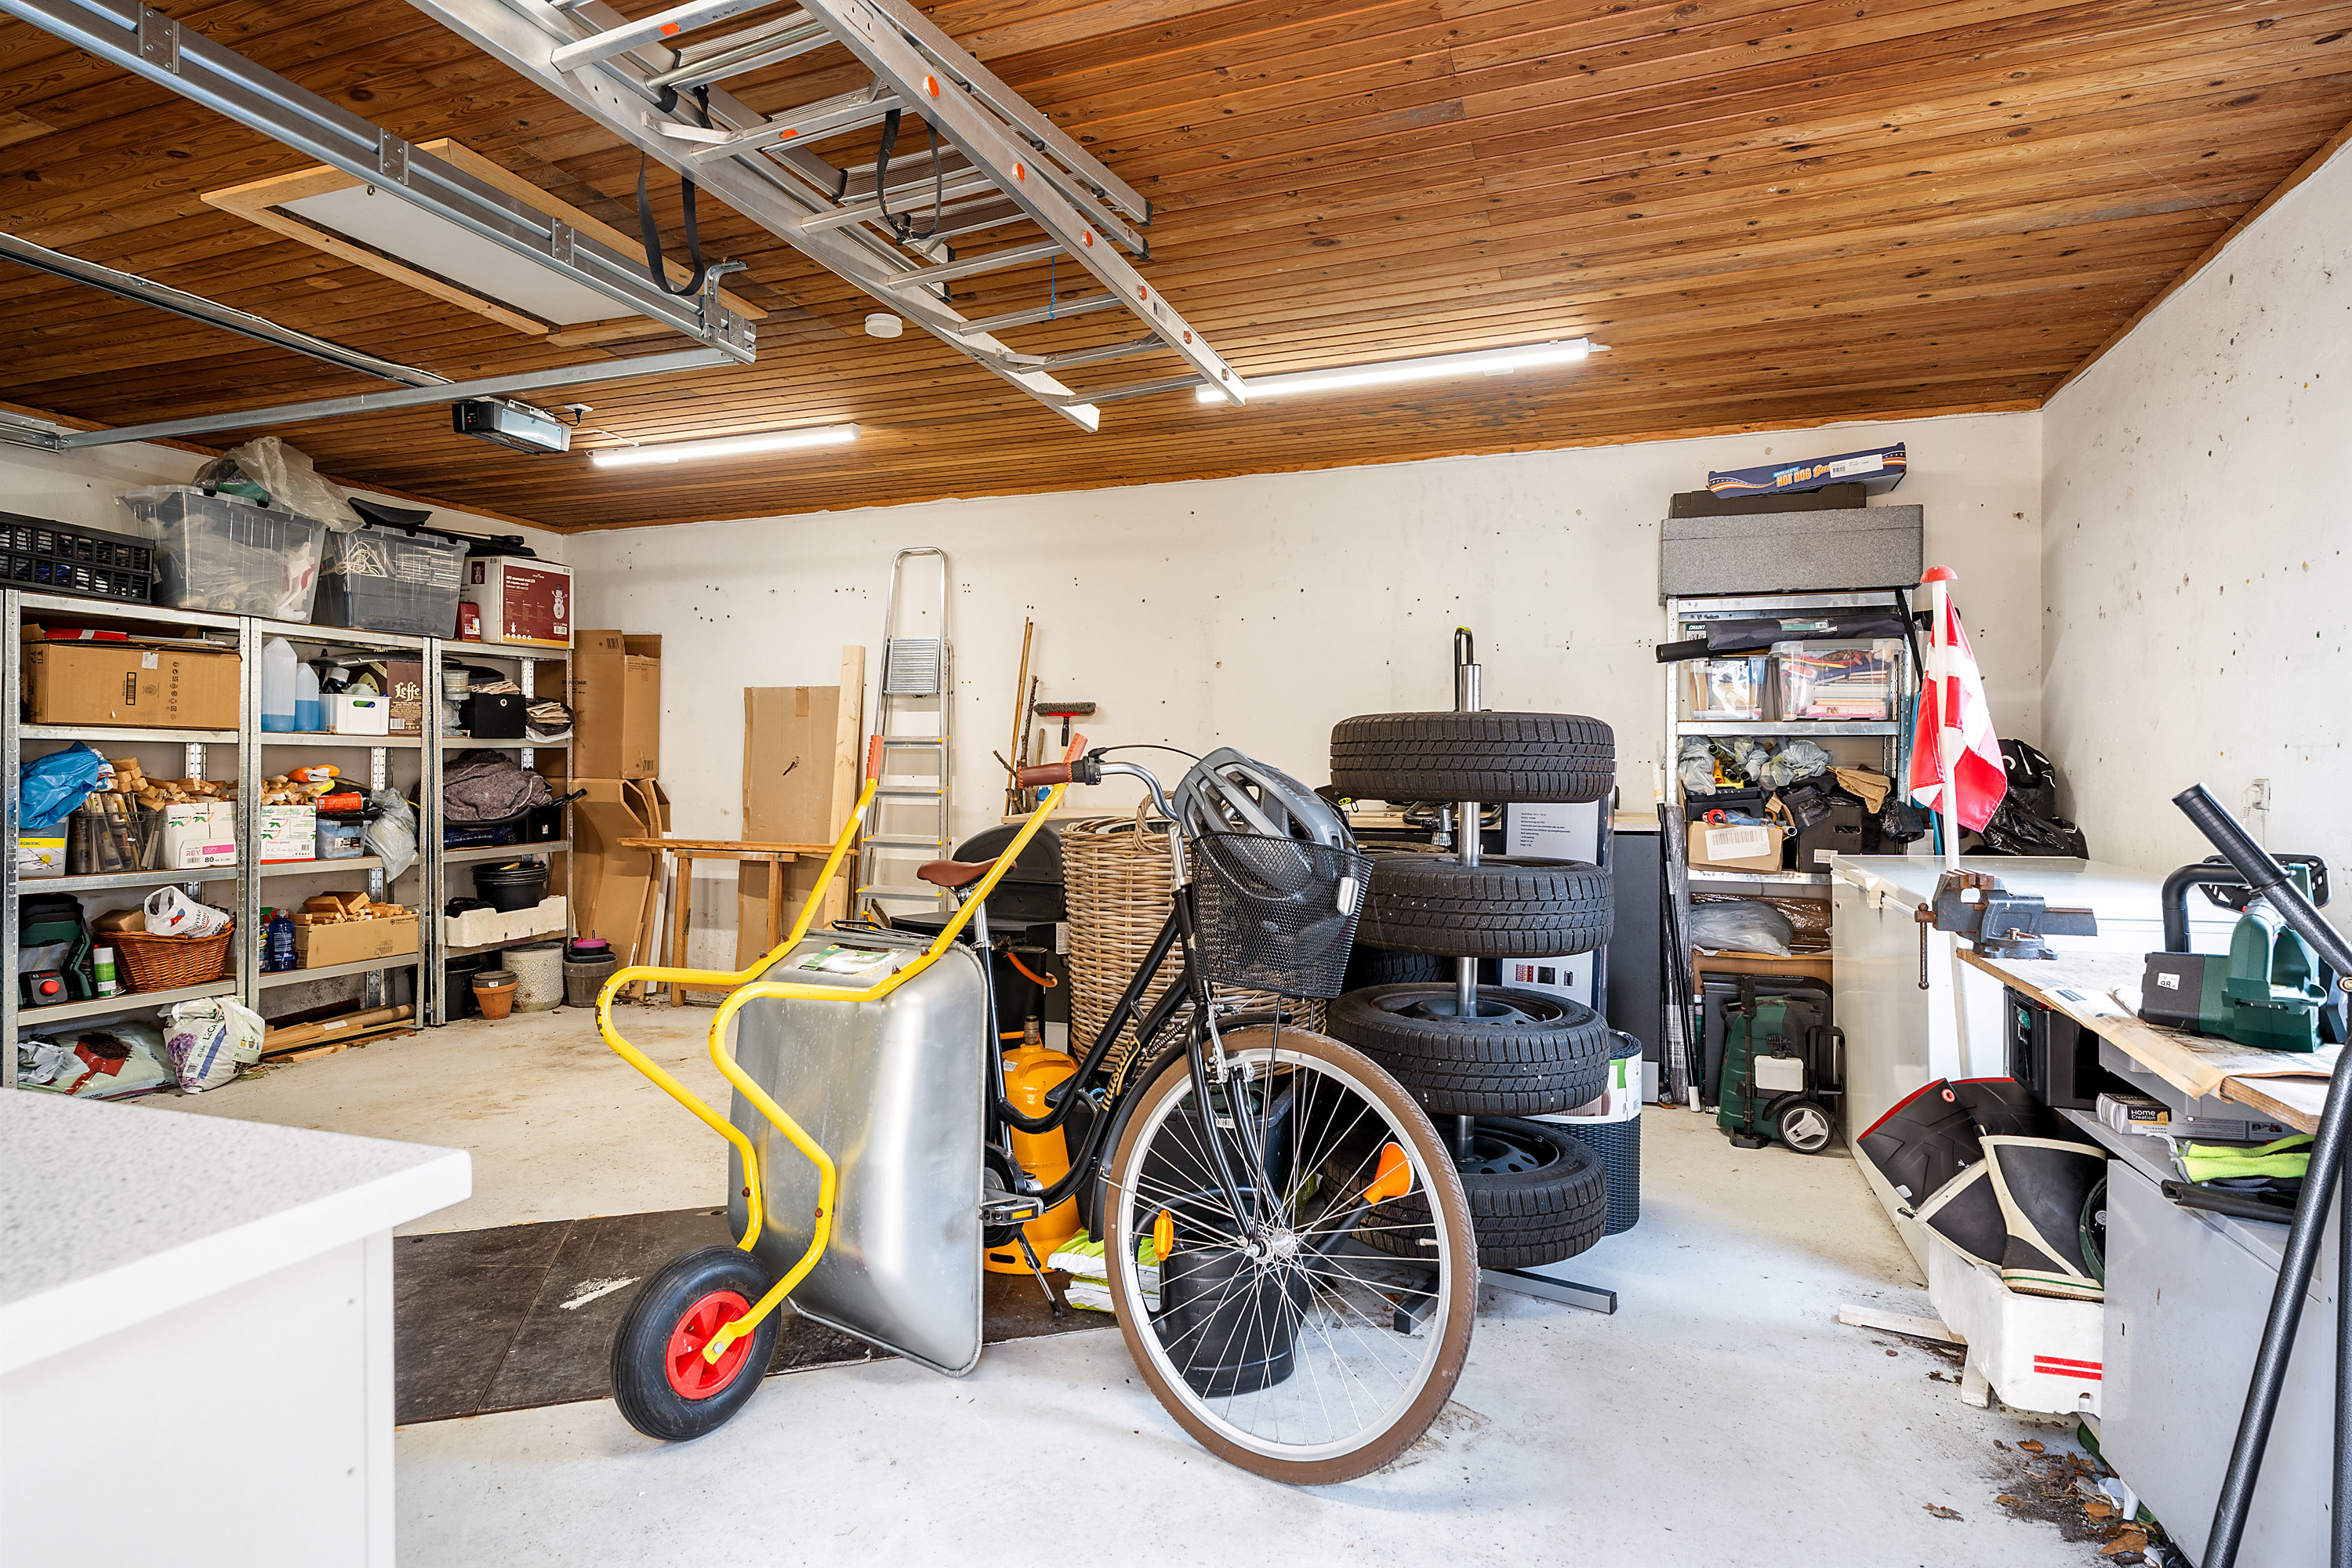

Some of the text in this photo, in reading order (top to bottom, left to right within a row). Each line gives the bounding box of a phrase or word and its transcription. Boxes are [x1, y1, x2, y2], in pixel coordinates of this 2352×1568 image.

[1774, 469, 1789, 477] AMERICAN
[1777, 473, 1794, 488] HOT
[1794, 468, 1812, 482] DOG
[394, 681, 421, 702] Leffe
[202, 1024, 218, 1040] LECA
